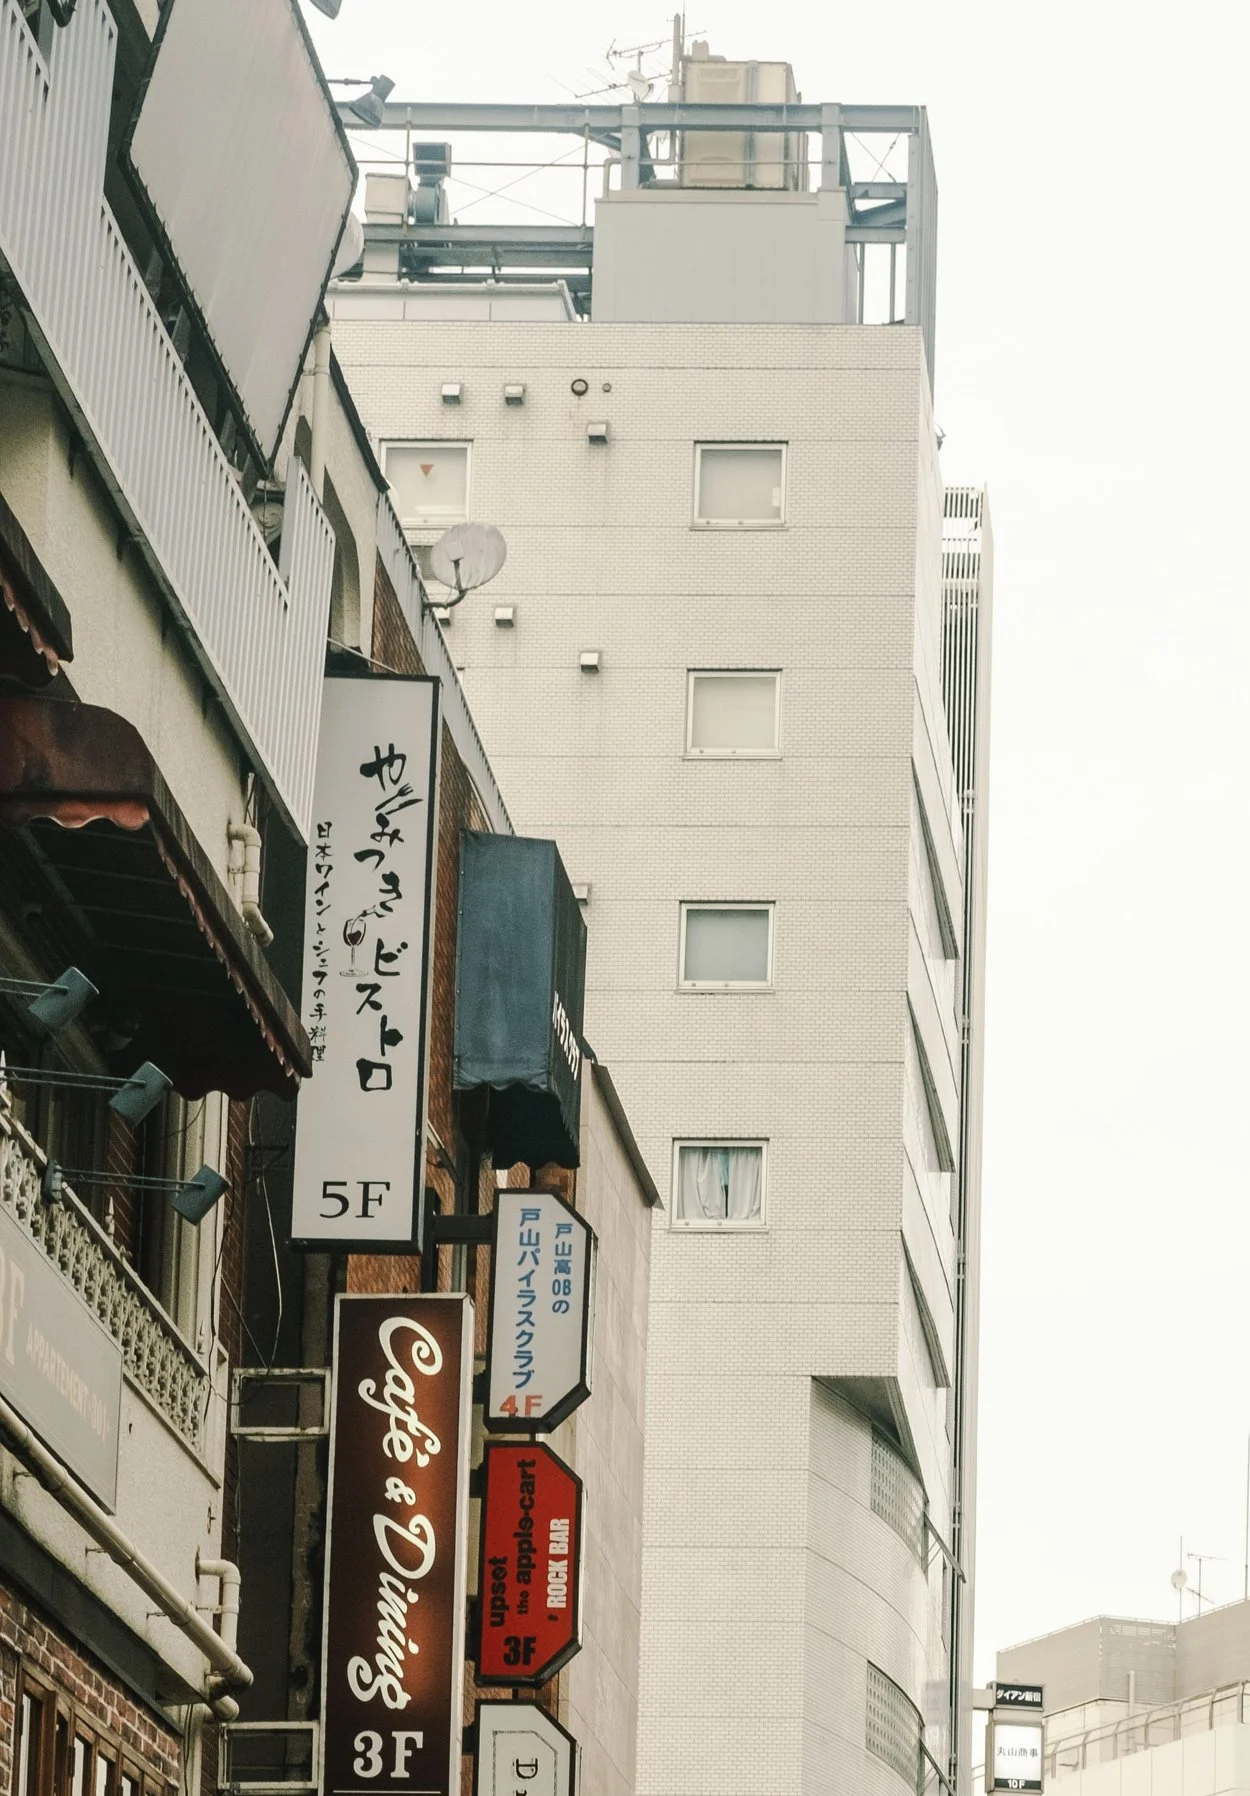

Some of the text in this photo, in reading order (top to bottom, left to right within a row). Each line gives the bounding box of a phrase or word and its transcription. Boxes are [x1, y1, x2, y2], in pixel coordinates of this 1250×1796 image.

[308, 820, 334, 1064] 日本ワインとシェフの手料理
[319, 1180, 391, 1220] 5F
[512, 1207, 542, 1389] 戸山パイラスクラブ
[551, 1222, 574, 1315] 戸山高OBの
[499, 1394, 543, 1418] 4F
[384, 1476, 418, 1507] &
[516, 1458, 537, 1616] the apple-cart
[547, 1517, 570, 1609] ROCK BAR
[346, 1512, 438, 1711] Dining
[488, 1554, 508, 1629] upset
[503, 1636, 537, 1667] 3F
[353, 1730, 424, 1779] 3F
[1007, 1779, 1026, 1790] 10F
